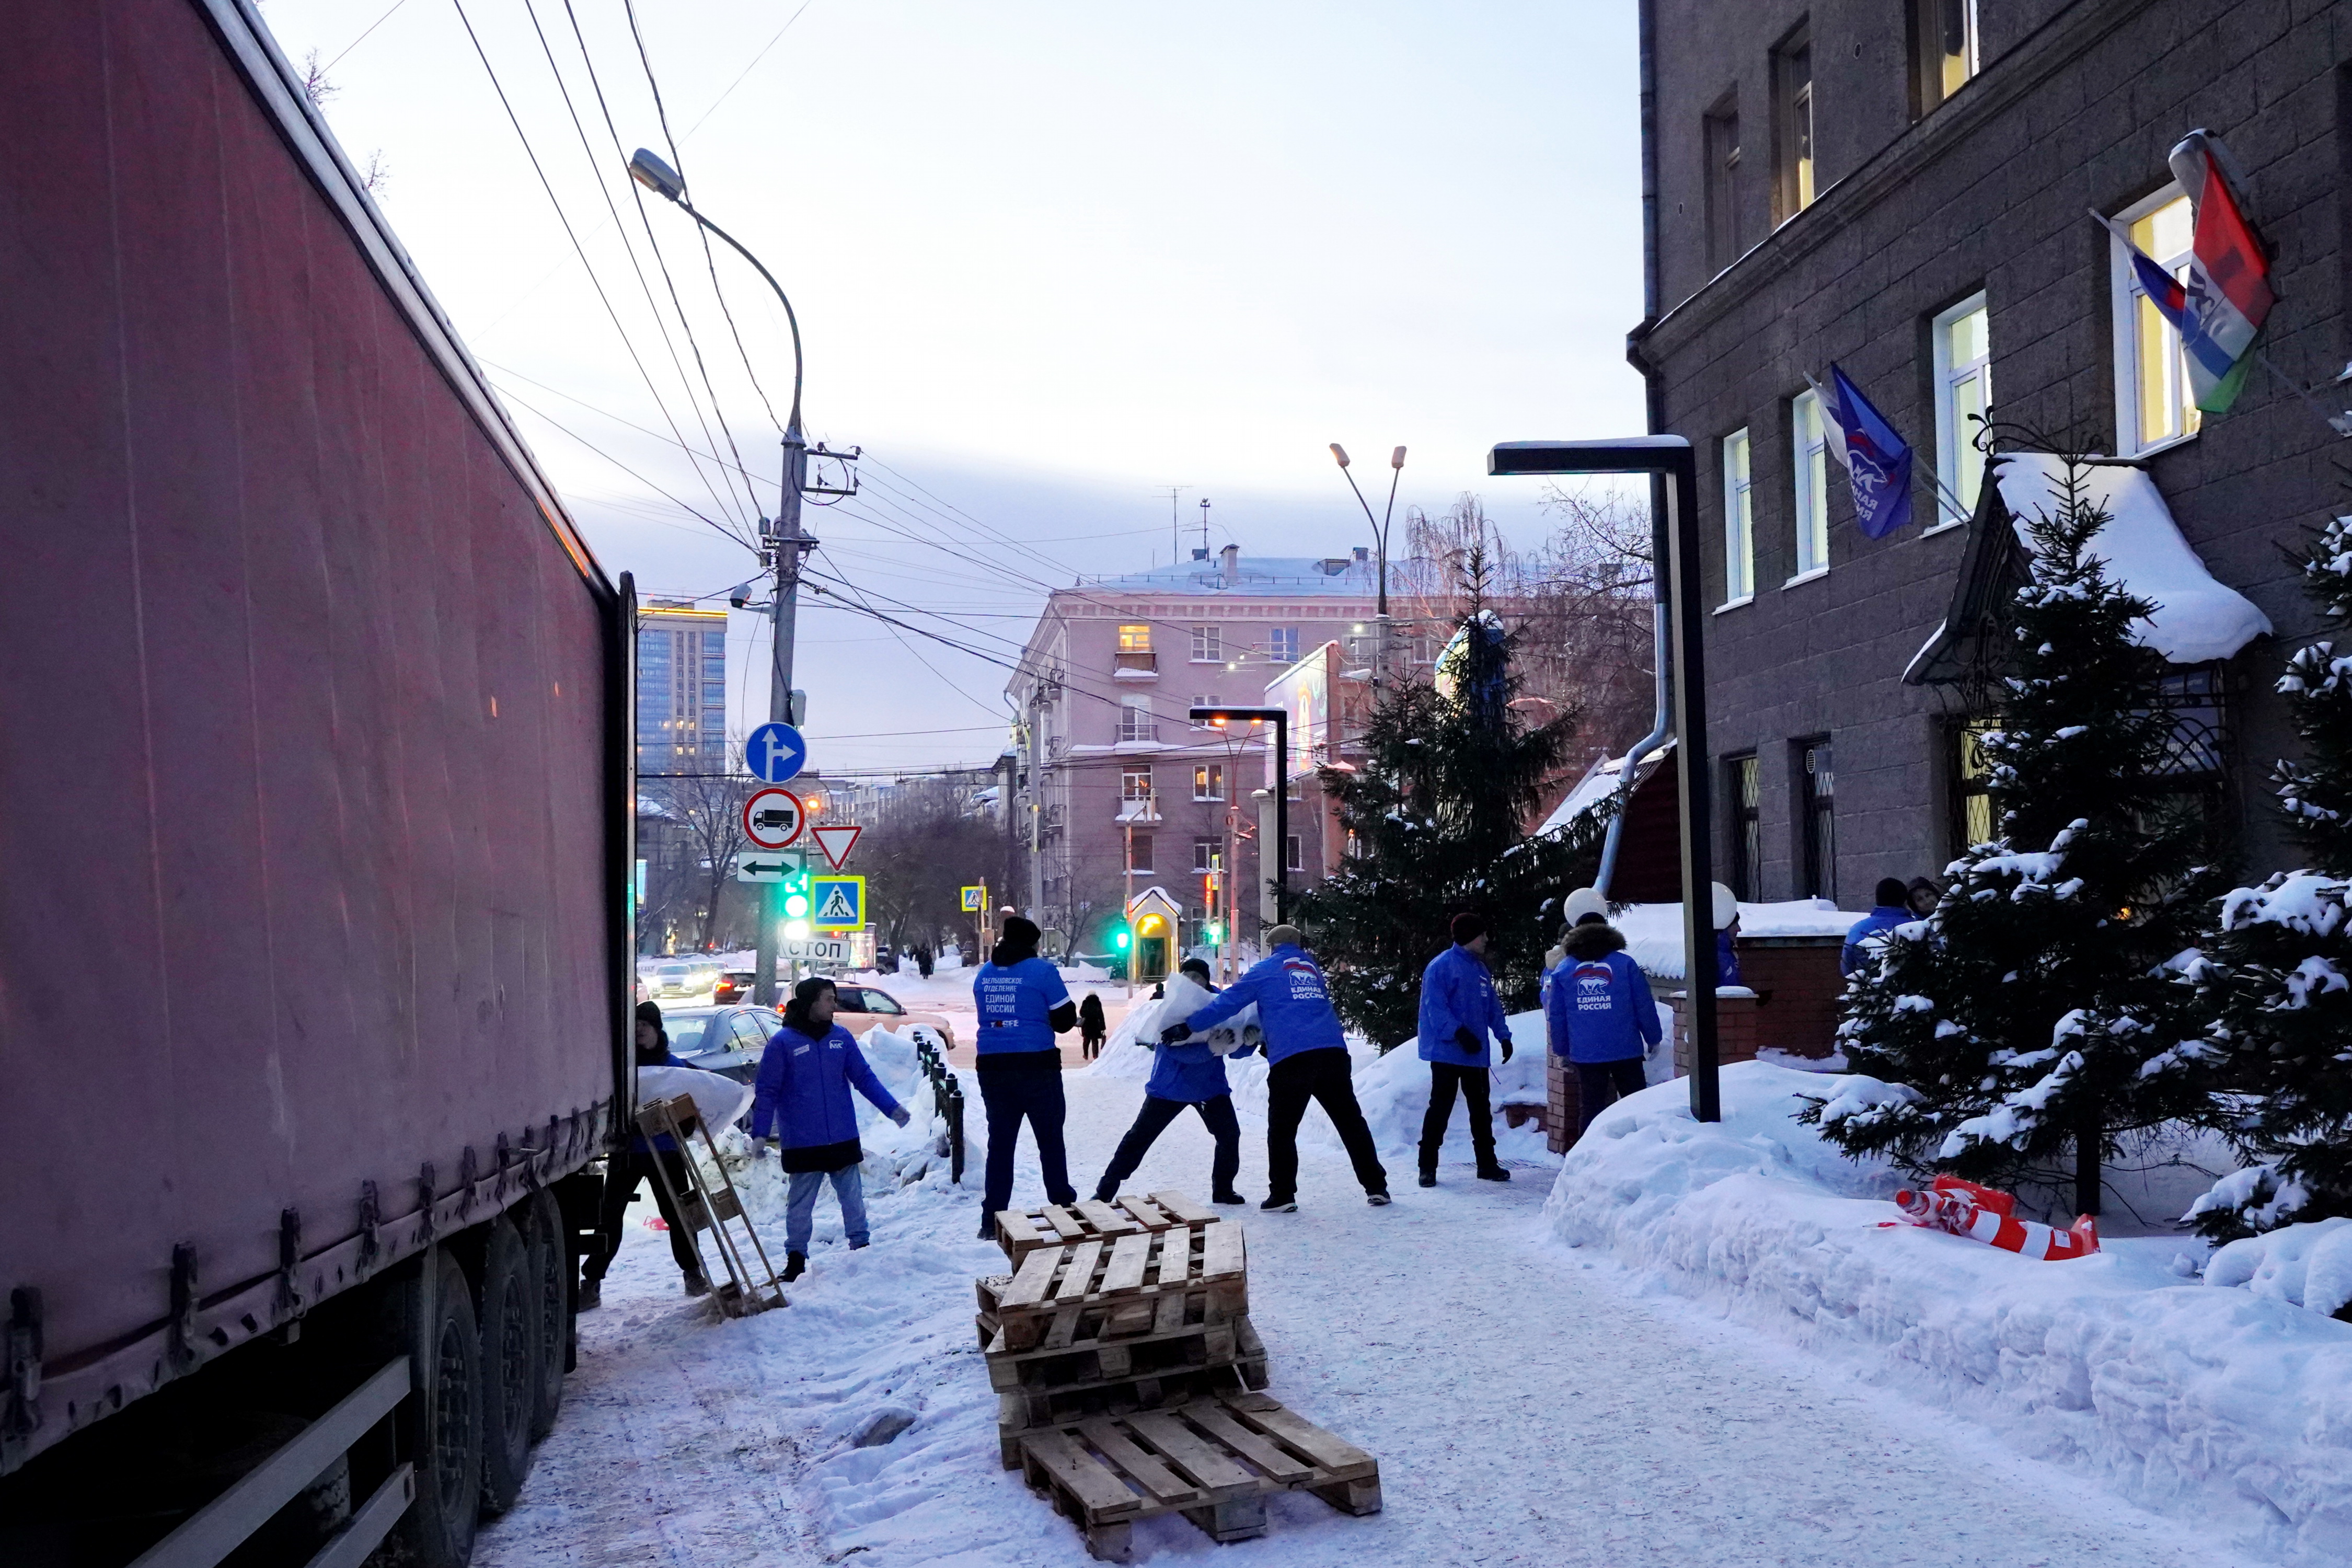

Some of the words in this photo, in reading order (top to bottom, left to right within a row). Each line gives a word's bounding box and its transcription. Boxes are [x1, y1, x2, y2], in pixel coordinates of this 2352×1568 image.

[789, 941, 840, 958] СТОП
[985, 994, 1015, 1004] ЕДИНОЙ
[1577, 995, 1611, 1004] ЕДИНАЯ
[986, 1005, 1015, 1013] РОССИИ
